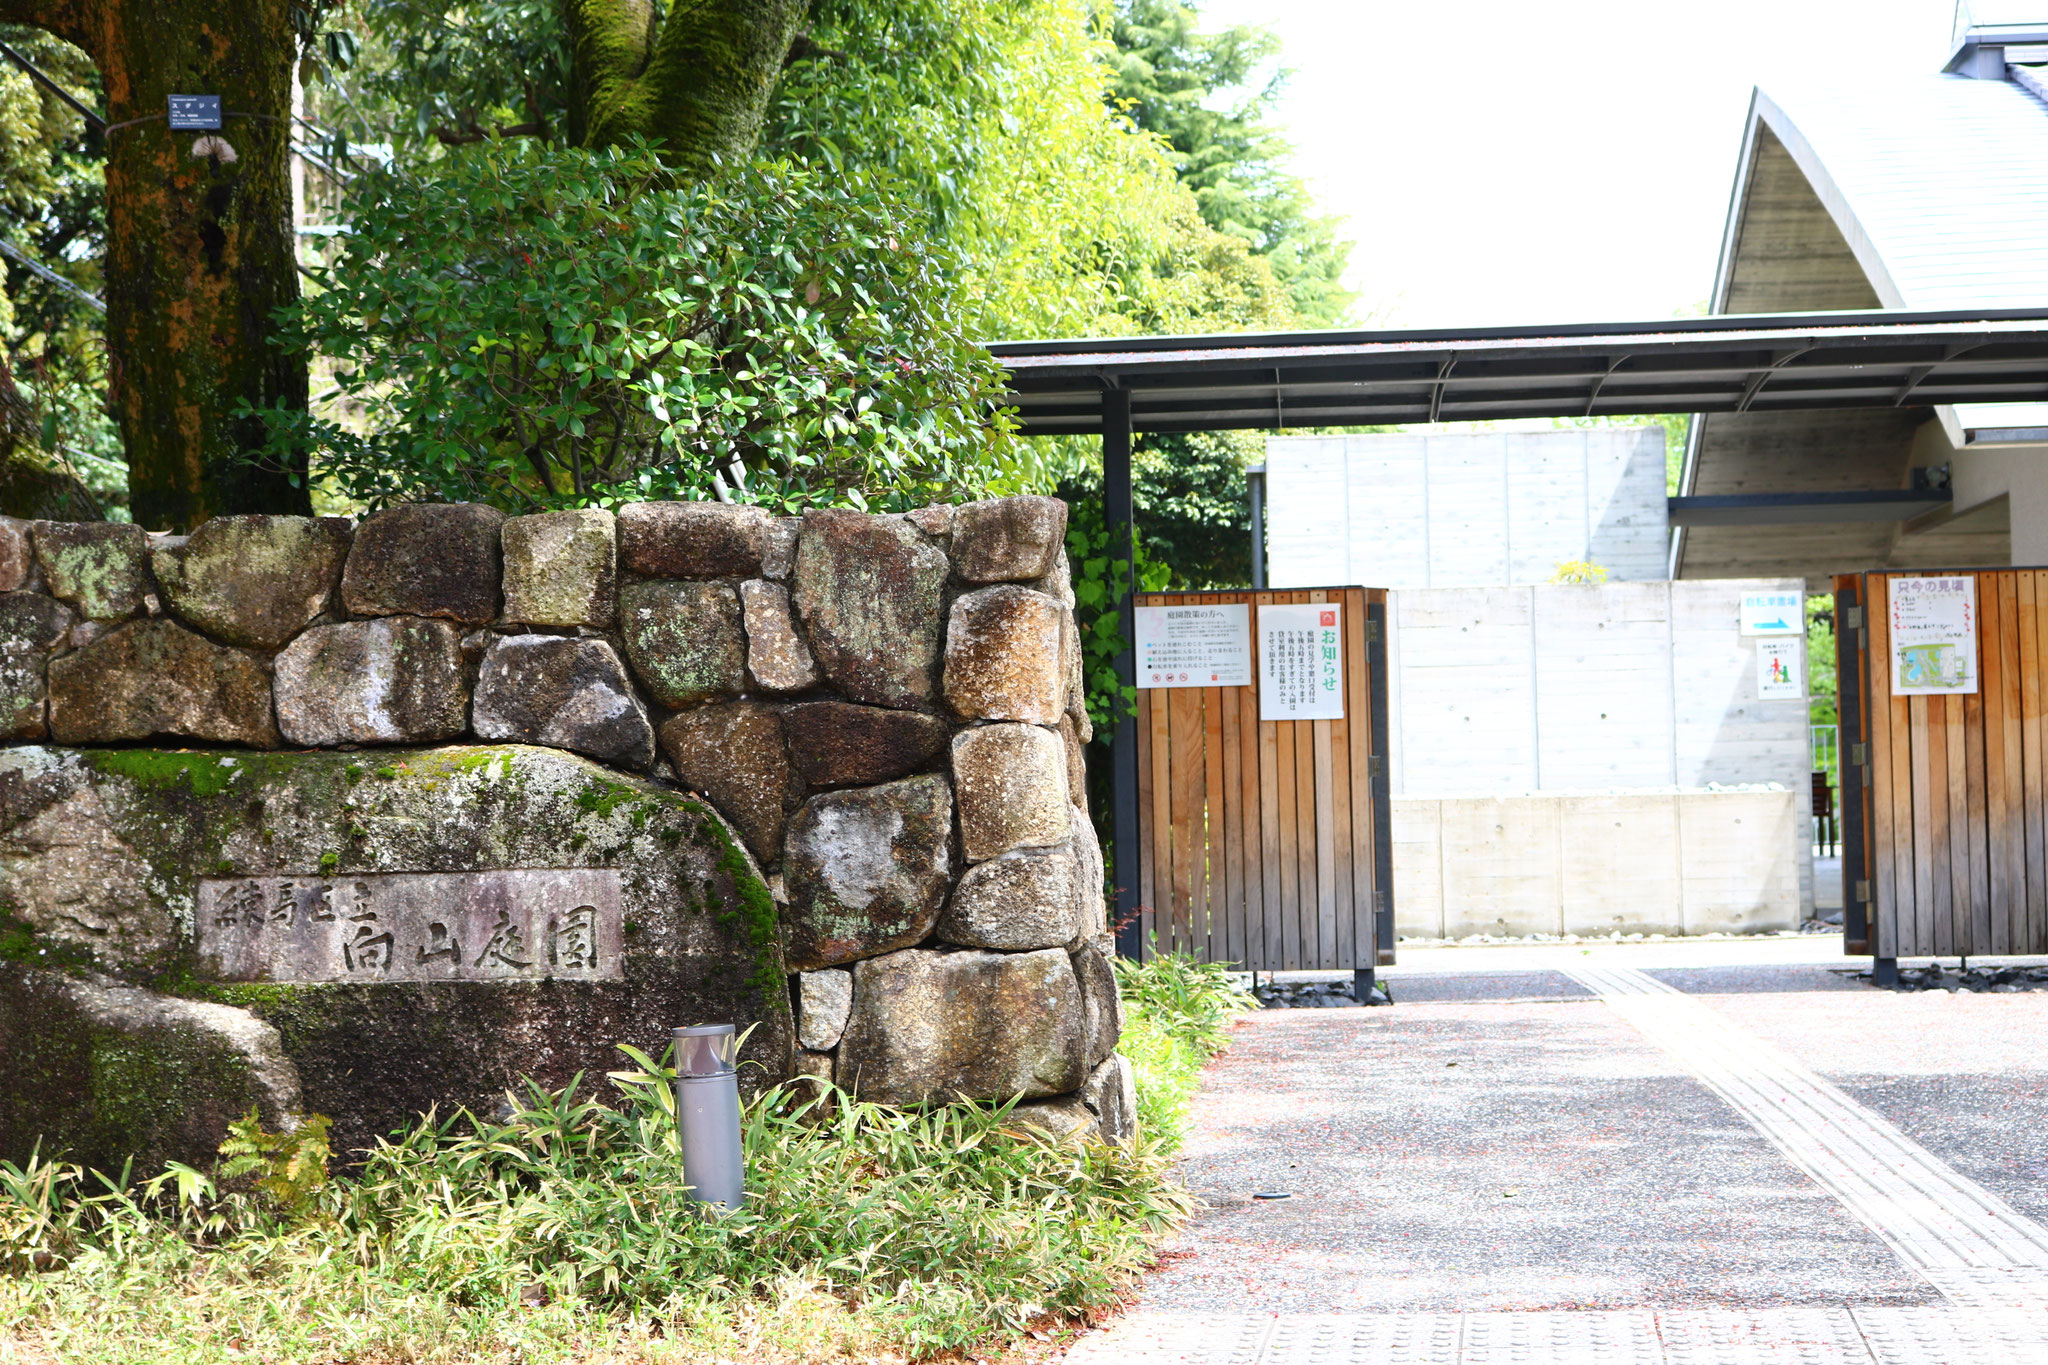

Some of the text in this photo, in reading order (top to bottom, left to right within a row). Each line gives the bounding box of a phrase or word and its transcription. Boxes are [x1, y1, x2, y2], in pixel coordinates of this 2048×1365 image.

[1167, 610, 1225, 620] 庭園散策の方へ
[1897, 580, 1965, 593] 只今の見頃
[1268, 631, 1276, 677] させて頂きます
[1278, 630, 1286, 704] 貸室利用のお客様のみと
[1287, 630, 1296, 711] 午後五時をすぎての入園は
[1297, 630, 1306, 704] 午後五時までとなります
[1307, 631, 1316, 704] 庭園の見学や窓口受付は
[1321, 630, 1337, 691] お知らせ
[214, 881, 377, 929] 練馬区立
[343, 904, 598, 974] 向山庭園
